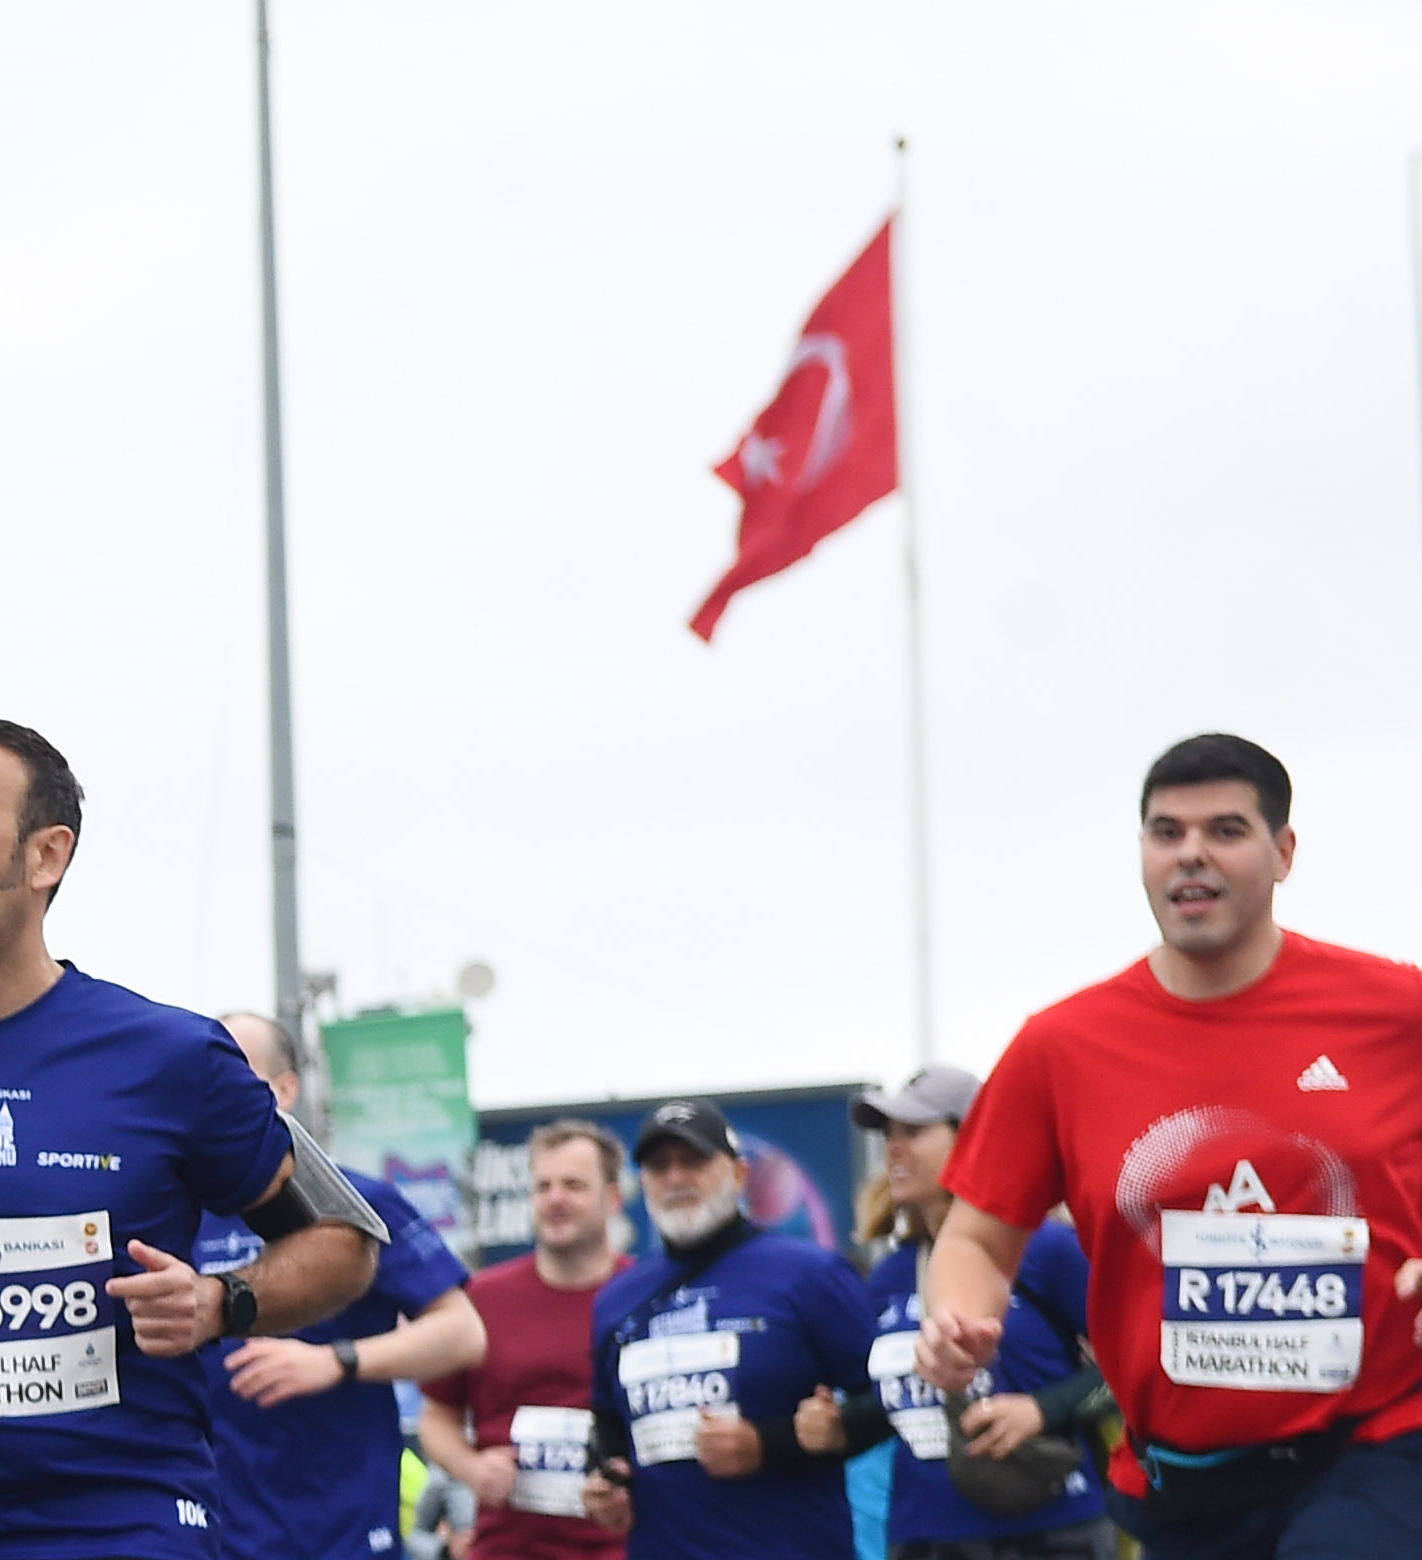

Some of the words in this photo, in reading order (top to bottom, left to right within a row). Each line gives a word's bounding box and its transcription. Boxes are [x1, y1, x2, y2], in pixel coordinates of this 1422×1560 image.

[36, 1151, 121, 1171] SPORTIVE
[4, 1239, 65, 1253] BANKASI
[1178, 1268, 1212, 1314] R
[1215, 1270, 1348, 1319] 17448
[12, 1353, 62, 1375] HALF
[1185, 1353, 1309, 1378] MARATHON
